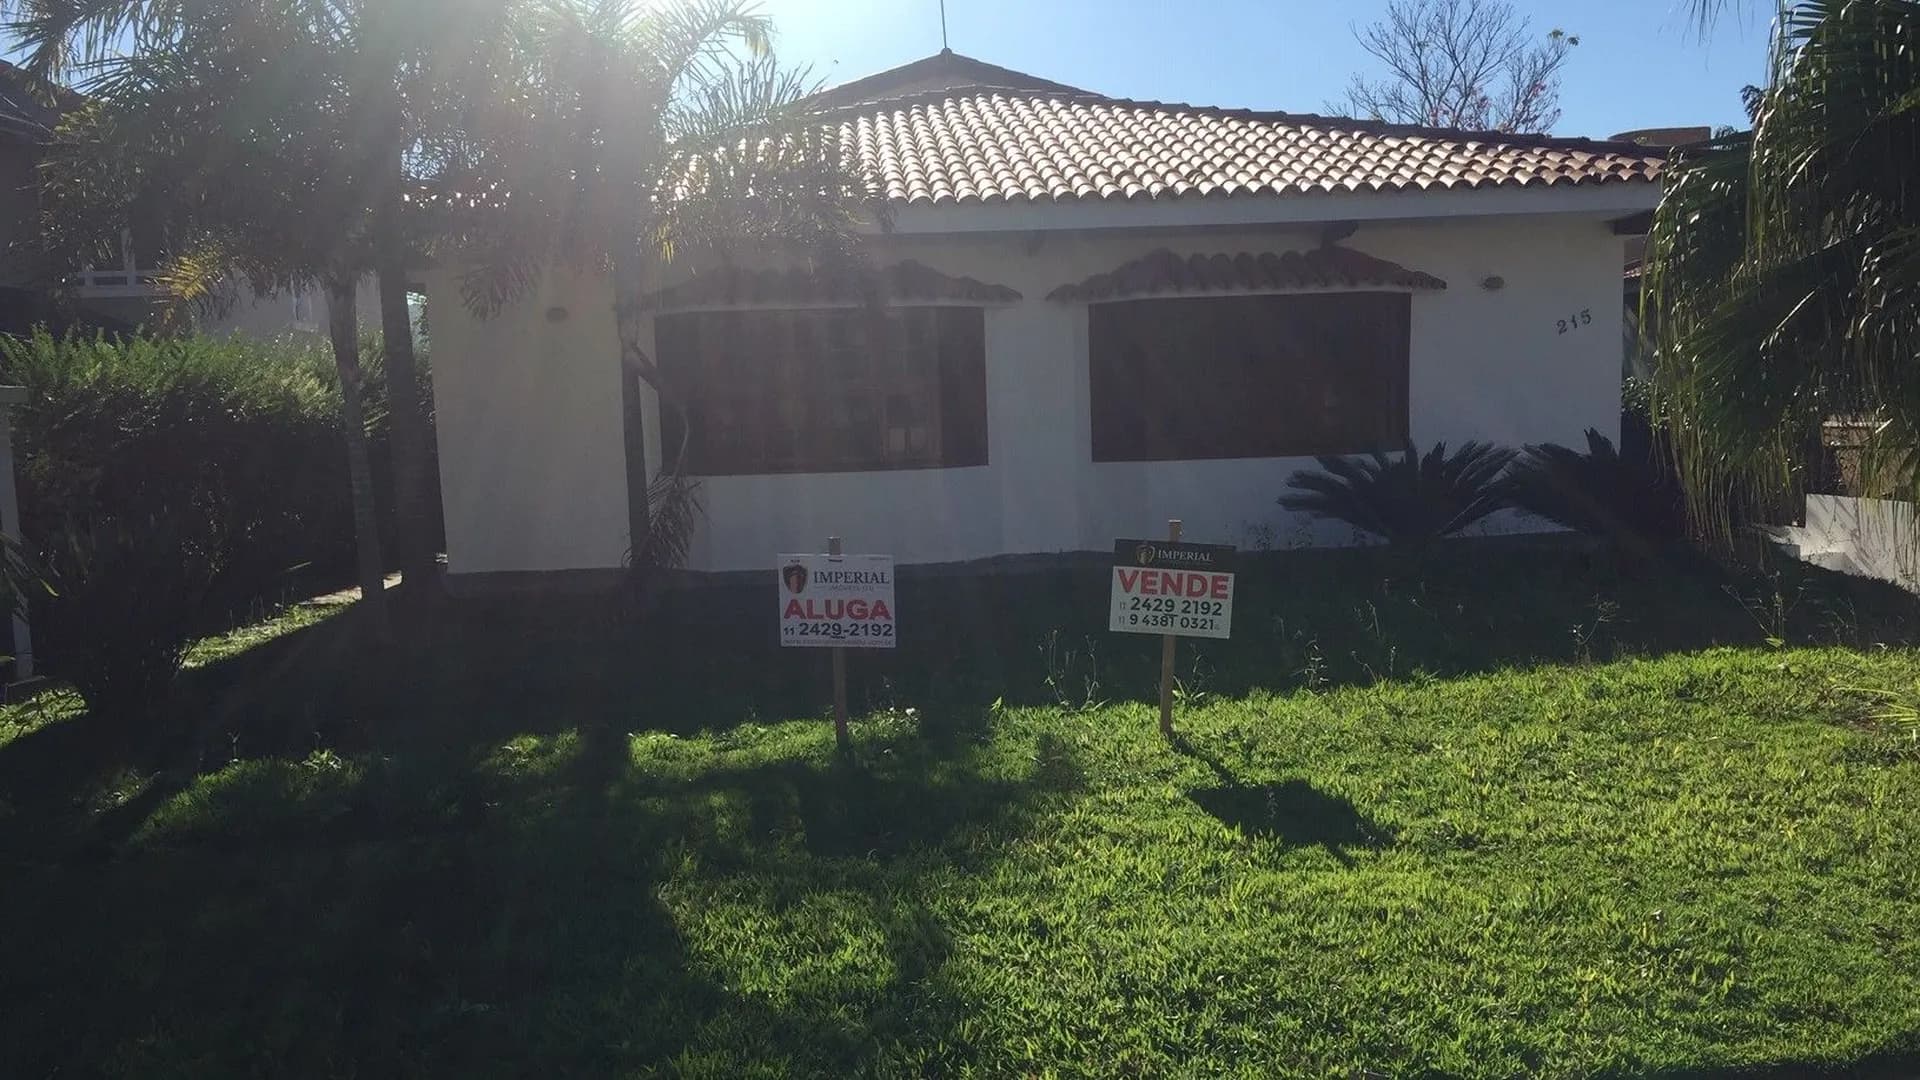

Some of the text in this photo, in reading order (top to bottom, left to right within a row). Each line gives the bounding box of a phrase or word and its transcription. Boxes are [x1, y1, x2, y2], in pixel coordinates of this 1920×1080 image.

[1556, 308, 1591, 336] 215
[1158, 549, 1214, 562] IMPERIAL
[814, 571, 890, 584] IMPERIAL
[1118, 569, 1229, 599] VENDE
[784, 599, 892, 620] ALUGA
[1130, 597, 1175, 612] 2429
[1181, 600, 1222, 616] 2192
[799, 622, 893, 637] 2429-2192
[1129, 614, 1138, 625] 9
[1180, 617, 1214, 630] 0321
